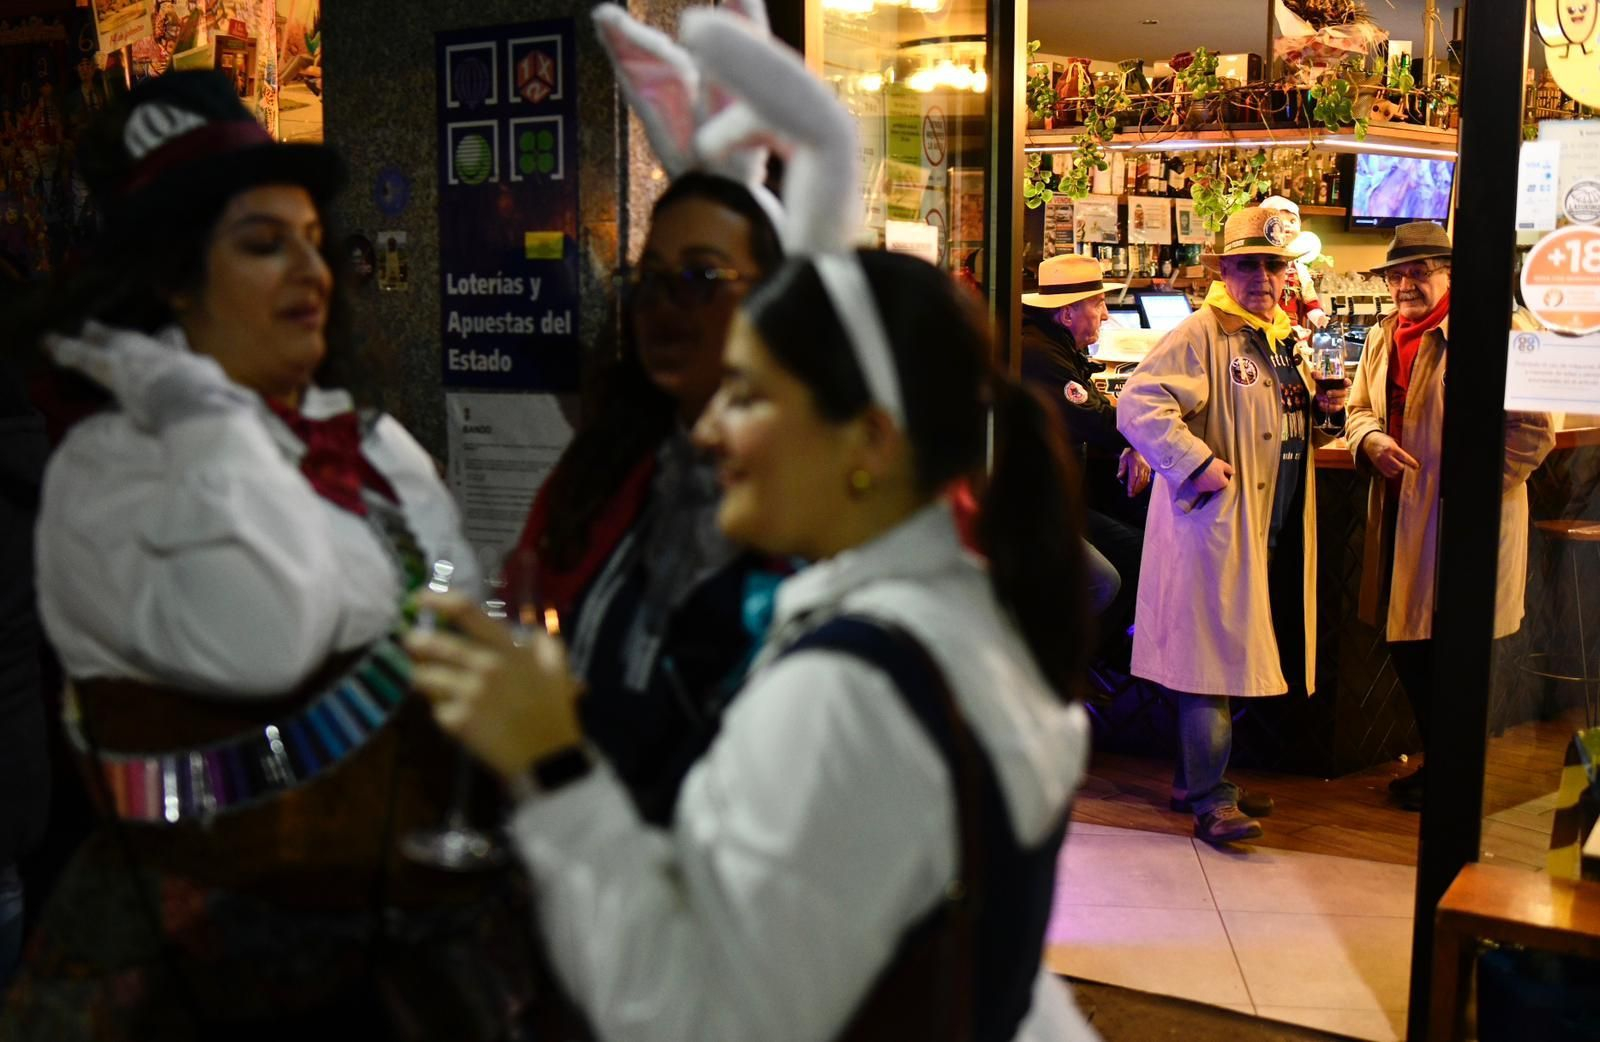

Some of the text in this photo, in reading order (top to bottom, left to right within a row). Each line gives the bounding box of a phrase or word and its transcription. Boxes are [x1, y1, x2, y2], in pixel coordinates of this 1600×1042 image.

[1547, 238, 1600, 273] +18
[447, 272, 542, 299] Loterías y
[447, 310, 572, 338] Apuestas del
[448, 348, 513, 373] Estado
